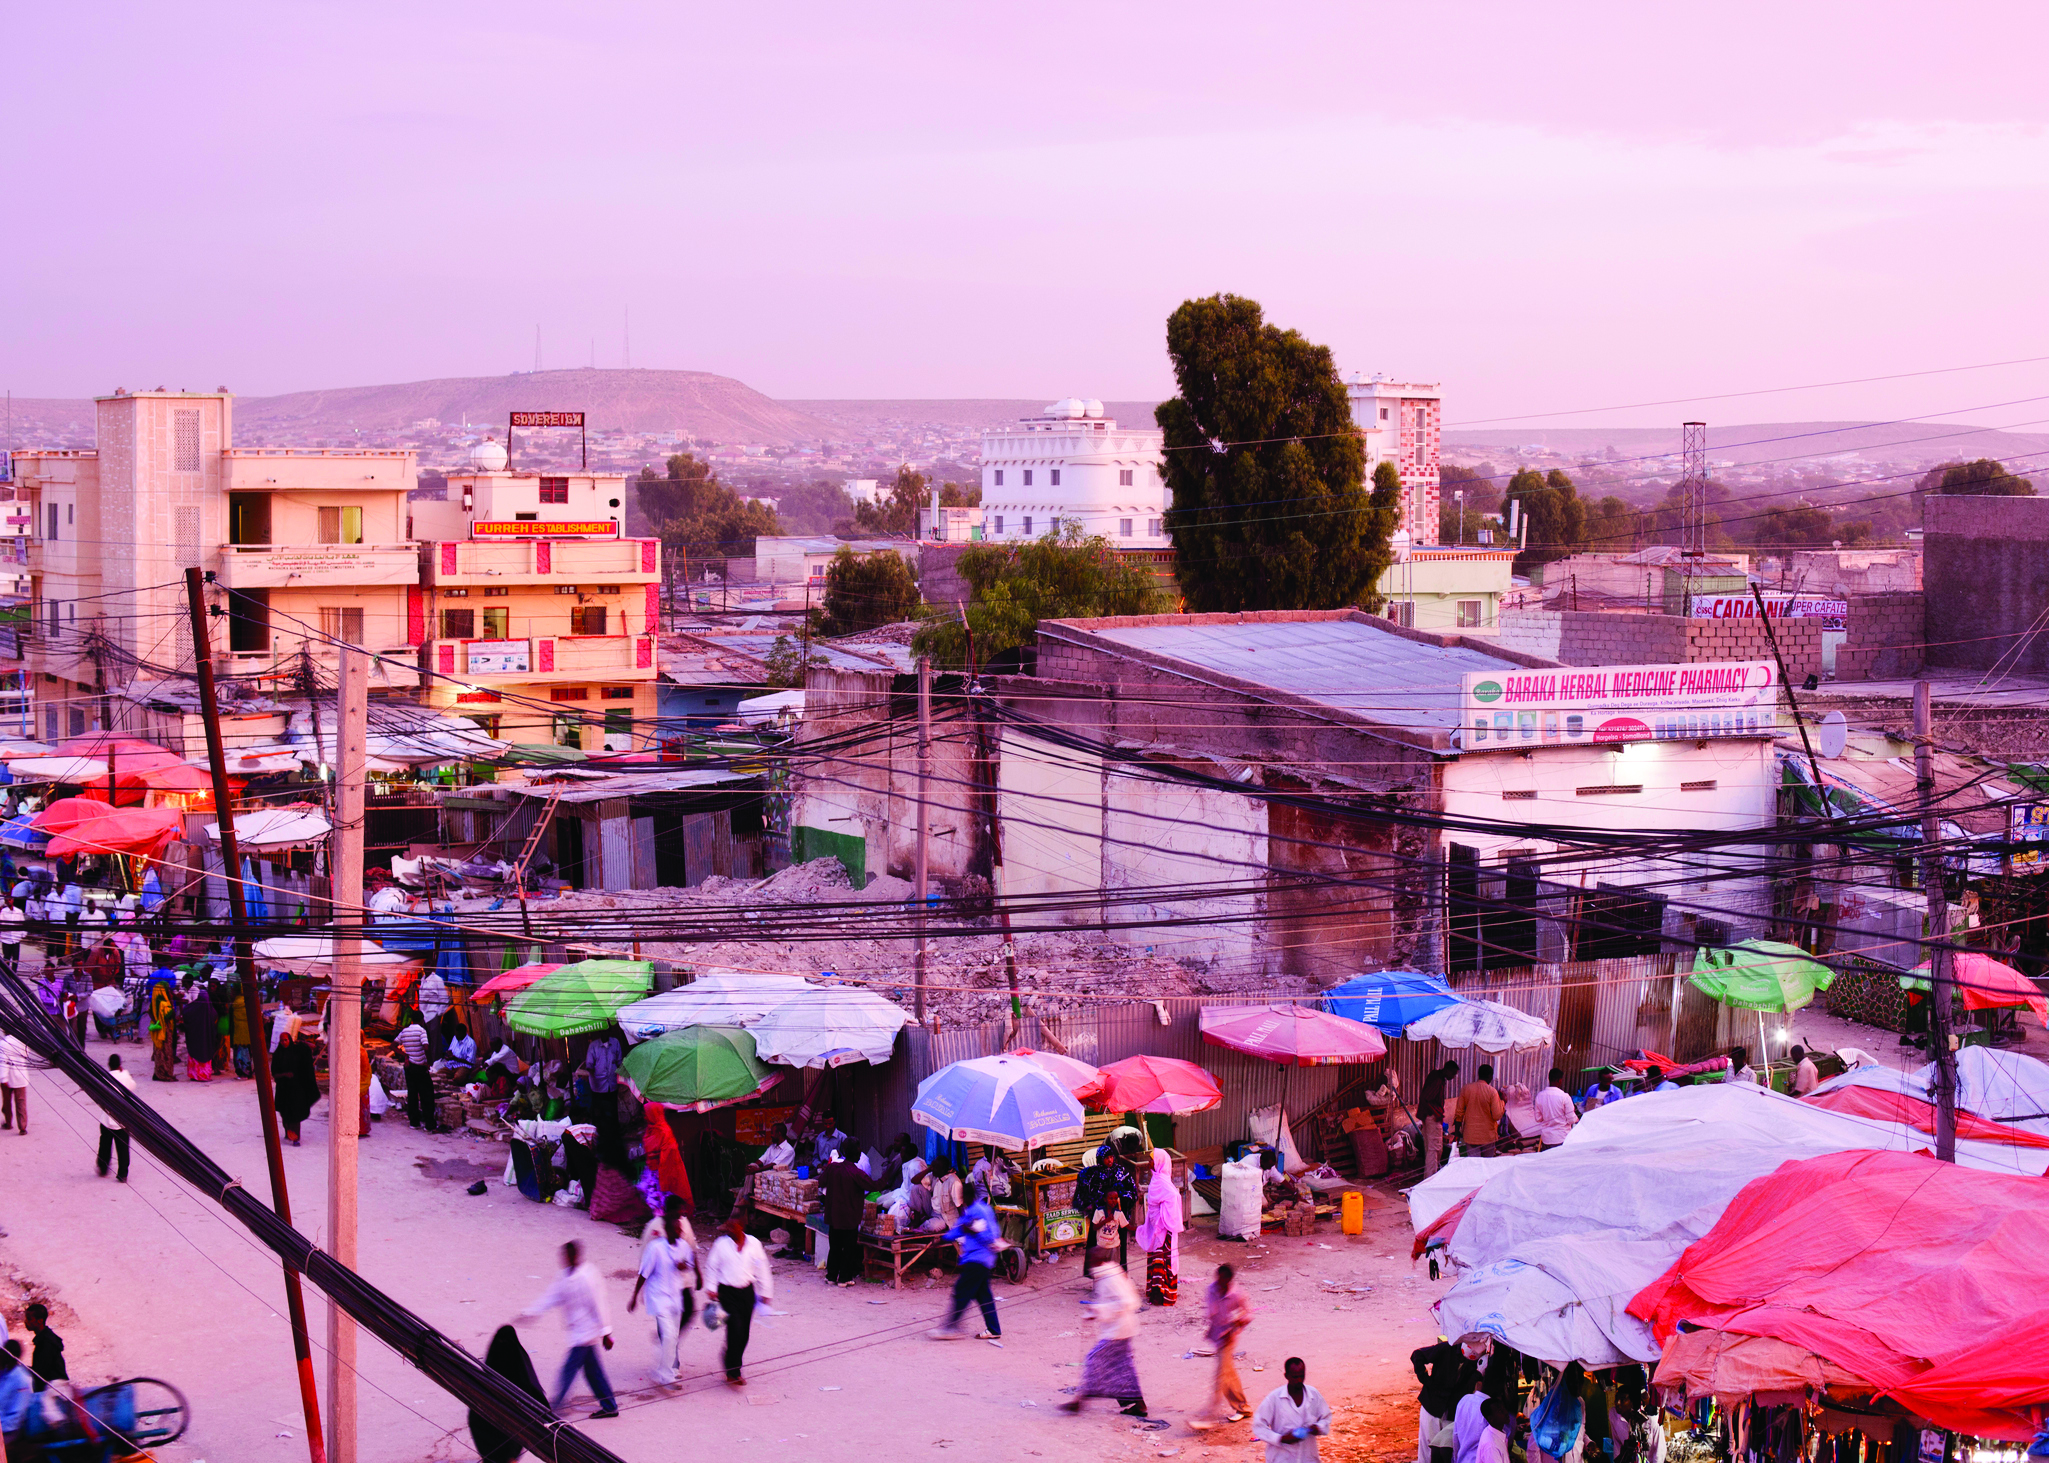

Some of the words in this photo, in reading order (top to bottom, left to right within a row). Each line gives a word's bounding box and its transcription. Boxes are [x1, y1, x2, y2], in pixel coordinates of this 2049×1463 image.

[476, 523, 529, 533] FURREH
[531, 523, 612, 533] ESTABLISHMENT
[1814, 602, 1847, 614] CAFATE
[1505, 675, 1556, 703] BARAKA
[1560, 673, 1607, 701] HERBAL
[1612, 670, 1677, 699] MEDICINE
[1679, 667, 1749, 696] PHARMACY
[1365, 987, 1383, 1005] MALL
[1732, 998, 1778, 1011] Dahabshiil
[1362, 1005, 1380, 1023] PALL
[559, 1021, 603, 1037] Dahabshiil
[1243, 1032, 1268, 1047] PALL
[1256, 1020, 1282, 1034] MALL
[1026, 1112, 1071, 1130] ROYALS
